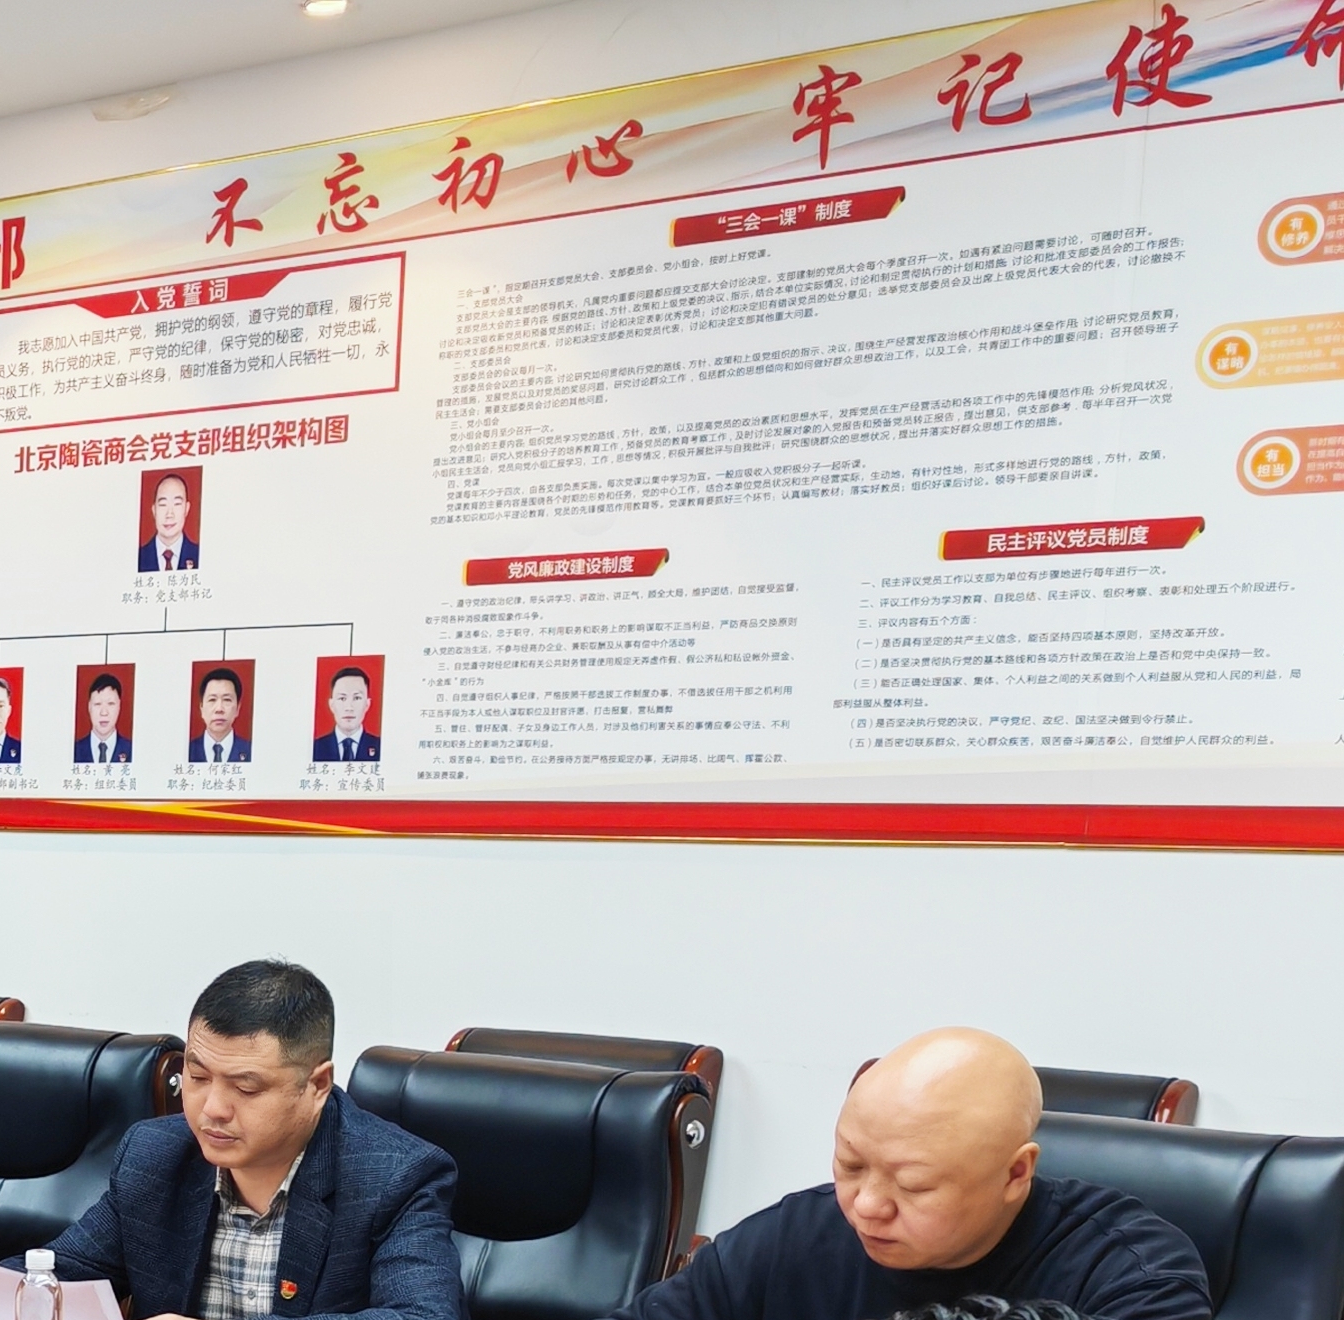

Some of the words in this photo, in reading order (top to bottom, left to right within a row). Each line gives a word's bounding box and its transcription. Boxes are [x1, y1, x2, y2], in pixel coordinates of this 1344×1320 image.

[204, 119, 647, 248] 不忘初心
[131, 278, 229, 314] 入党誓词
[14, 415, 349, 474] 北京陶瓷商会党支部组织架构图
[987, 524, 1148, 553] 民主评议党员制度
[508, 555, 635, 579] 党风廉政建设制度
